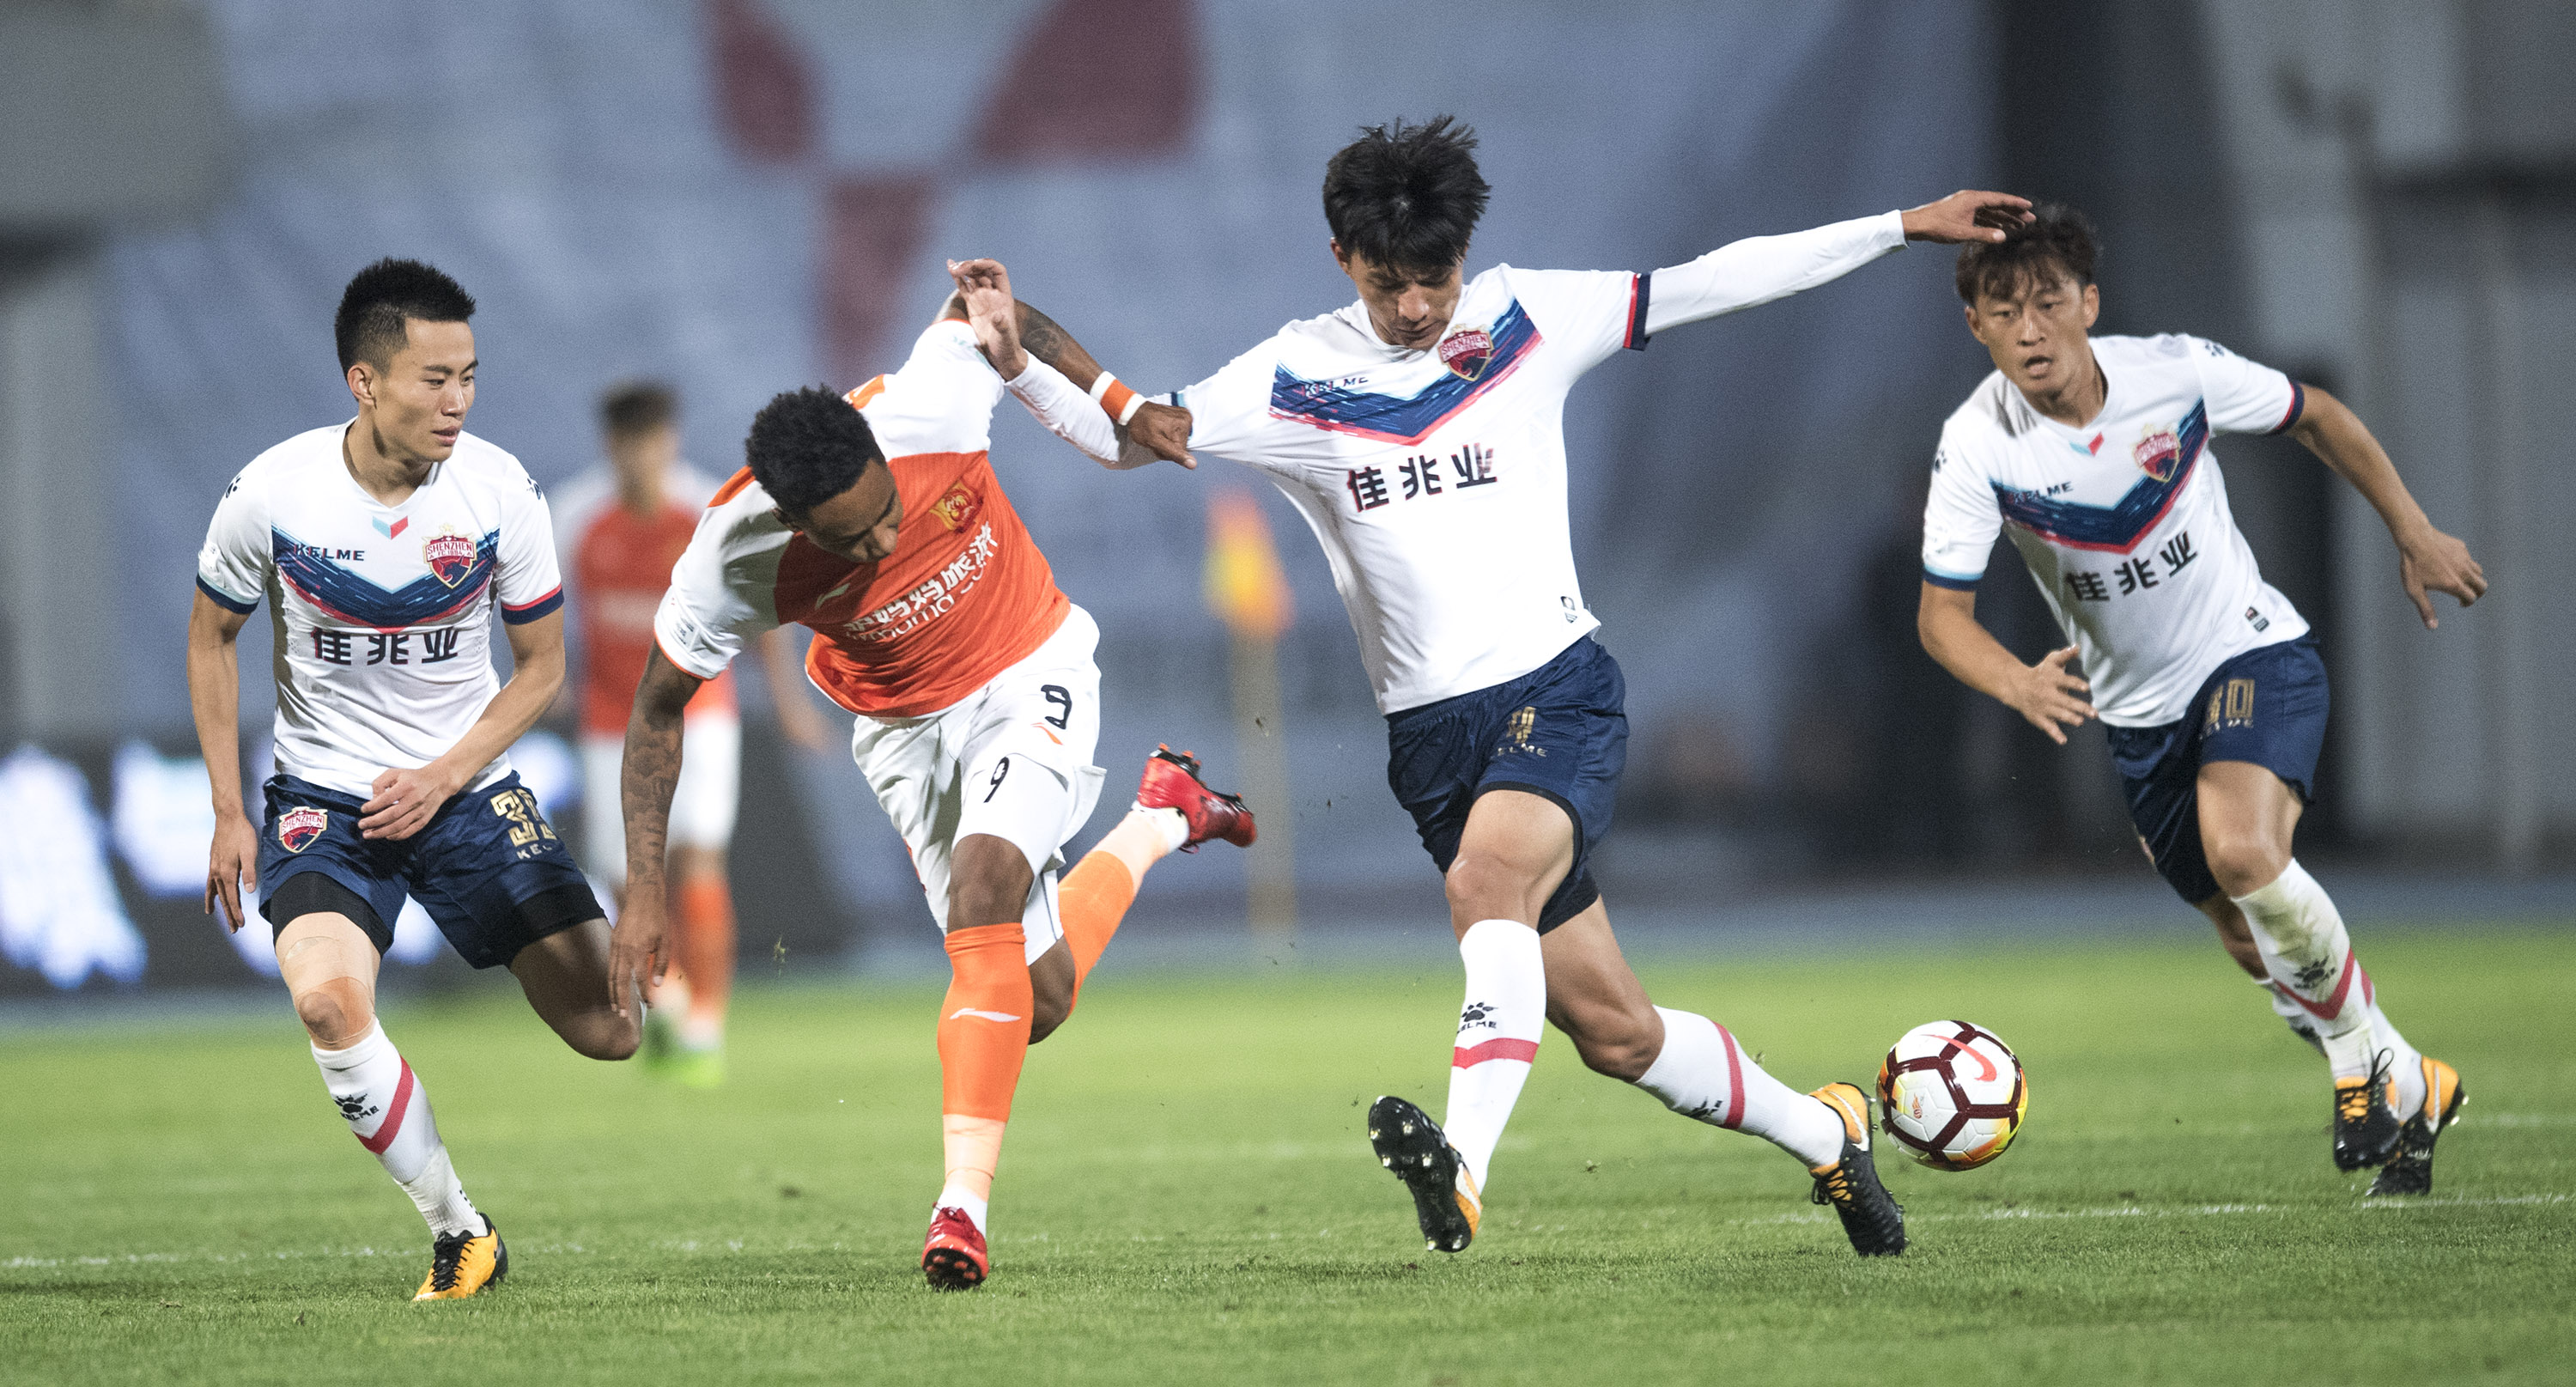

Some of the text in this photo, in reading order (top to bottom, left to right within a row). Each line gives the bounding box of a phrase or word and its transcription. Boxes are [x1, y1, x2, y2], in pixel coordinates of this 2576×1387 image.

[1347, 443, 1498, 512] 佳兆业
[294, 542, 365, 561] KELME
[427, 541, 472, 555] SHENZHEN
[2065, 530, 2197, 602] 佳兆业
[311, 626, 459, 666] 佳兆业
[1041, 684, 1073, 731] 9
[983, 756, 1010, 804] 9
